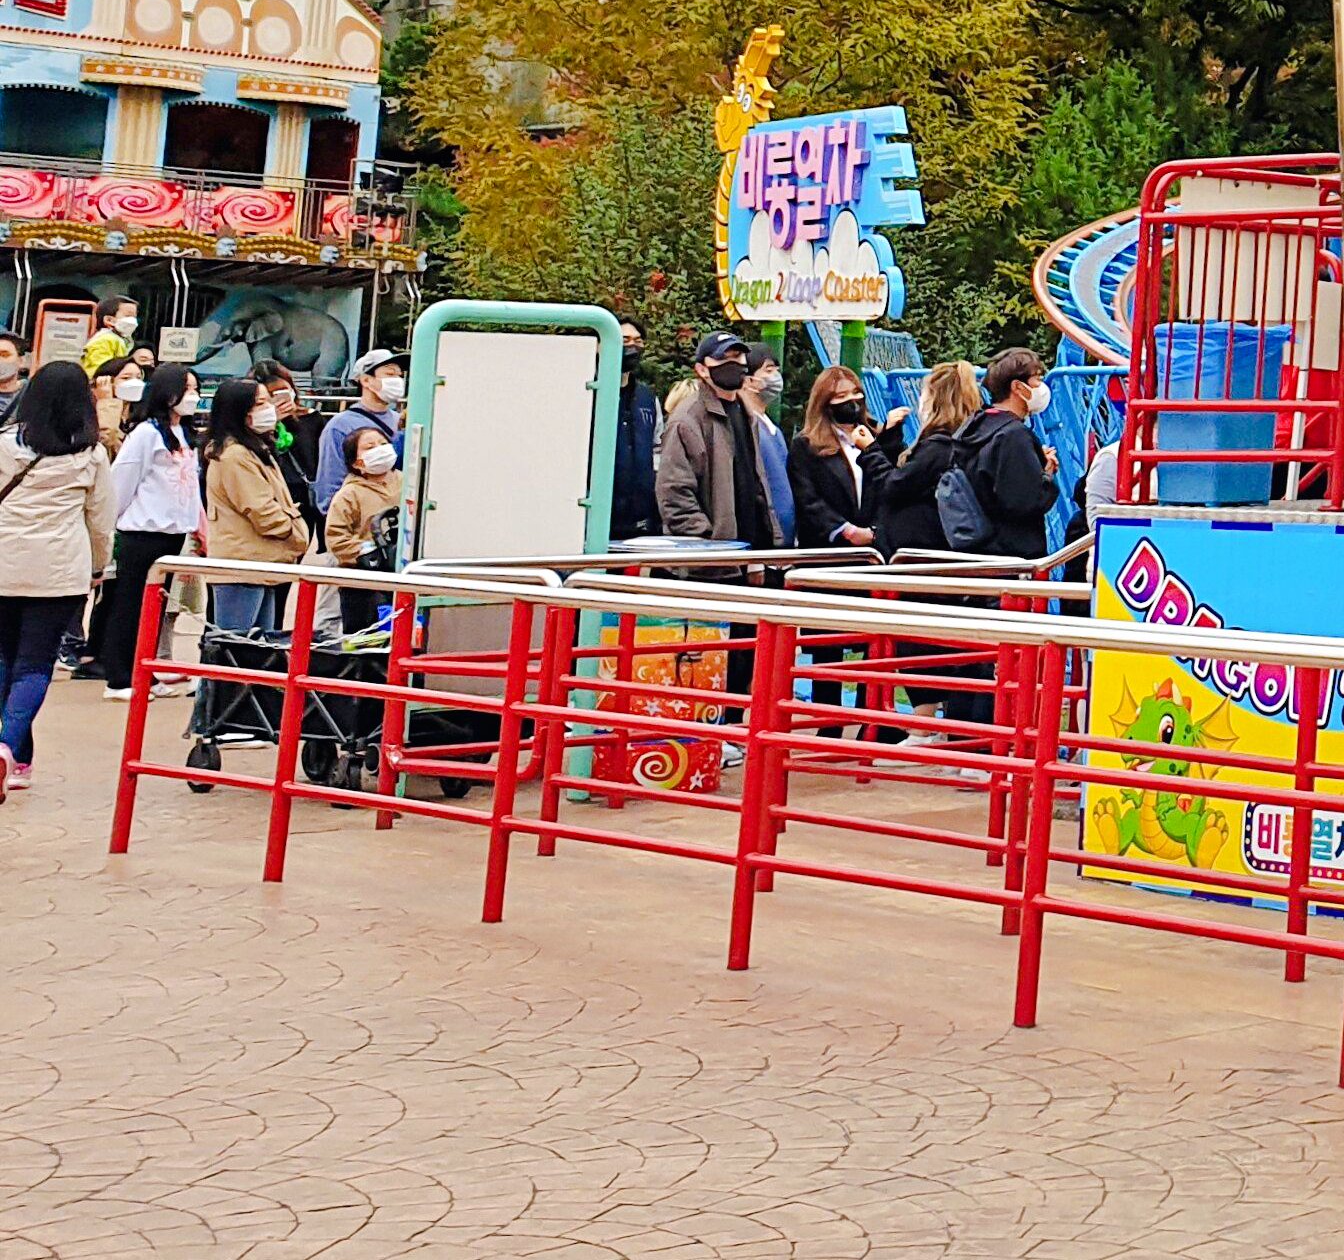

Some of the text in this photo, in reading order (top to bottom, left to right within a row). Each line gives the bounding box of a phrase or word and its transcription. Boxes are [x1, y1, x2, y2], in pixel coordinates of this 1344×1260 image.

[738, 119, 871, 250] 비룡열차
[775, 271, 784, 303] 2
[787, 271, 822, 309] Loop
[823, 270, 885, 303] Coaster
